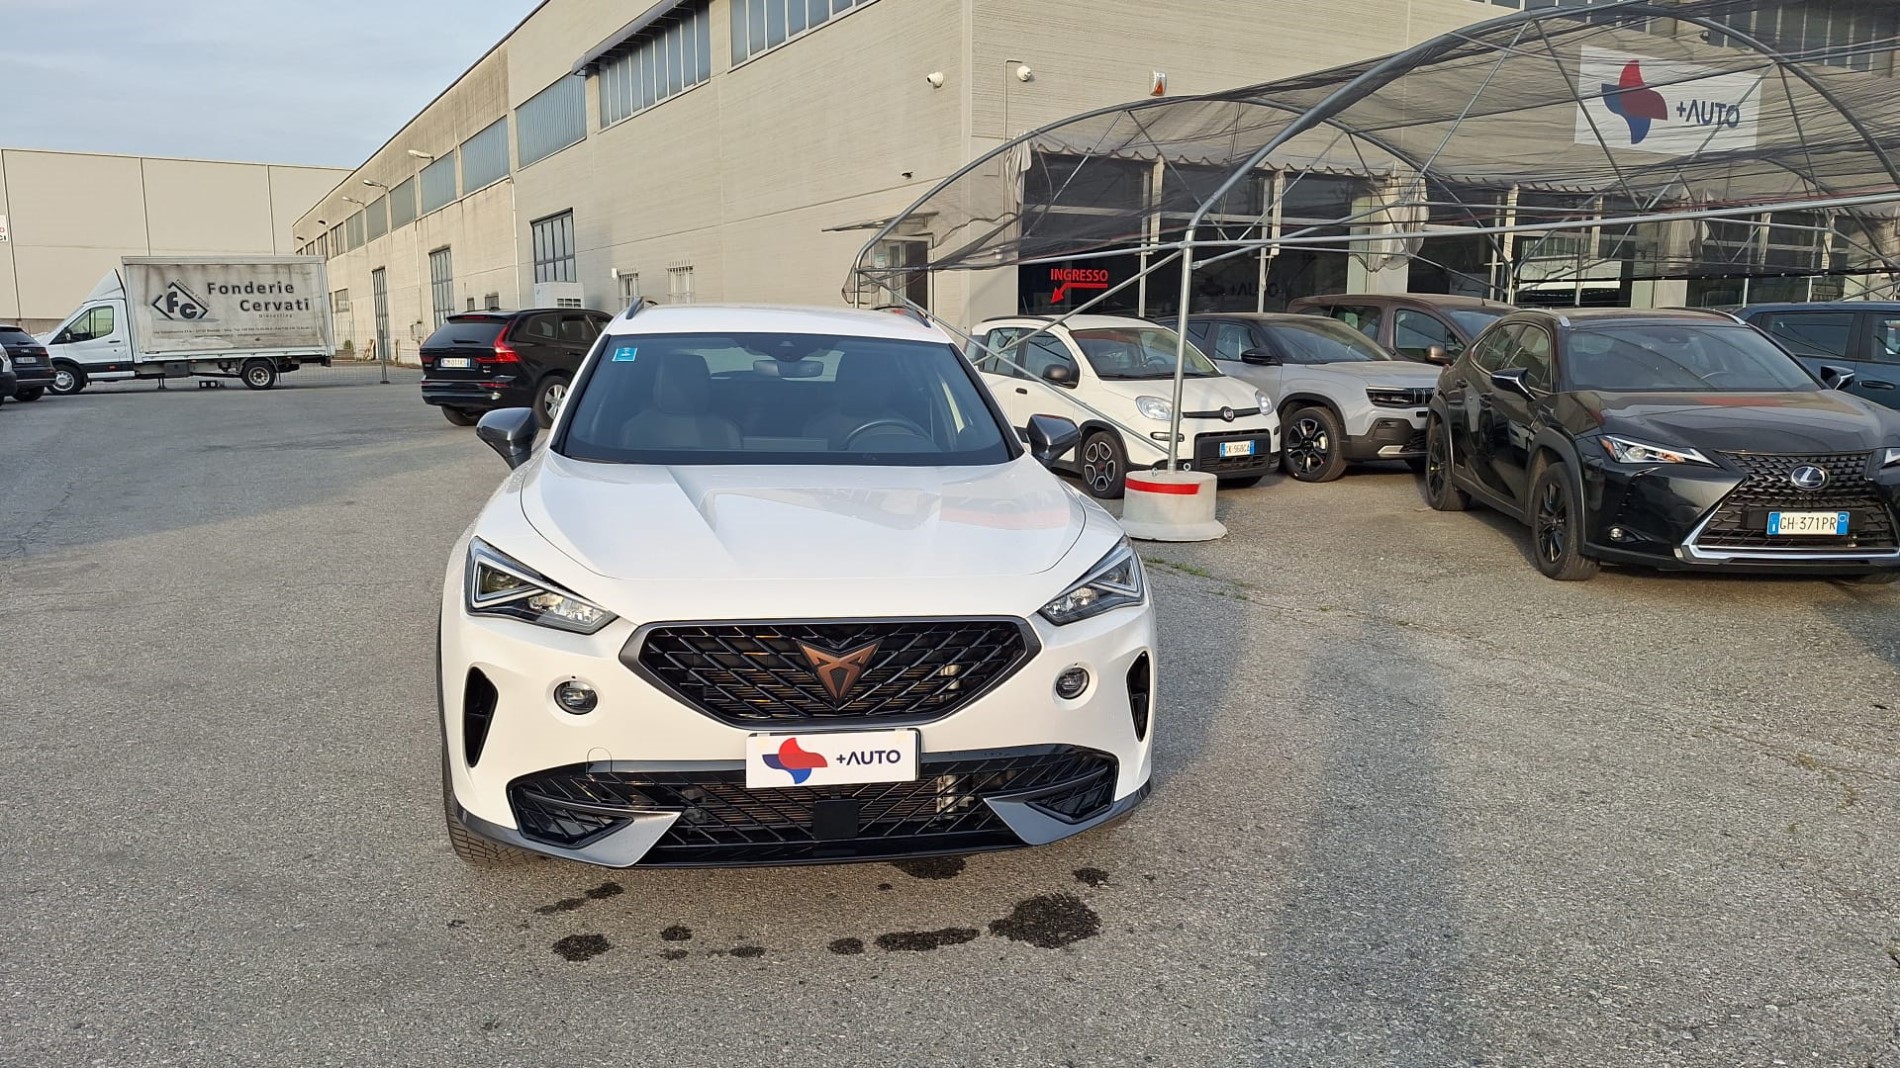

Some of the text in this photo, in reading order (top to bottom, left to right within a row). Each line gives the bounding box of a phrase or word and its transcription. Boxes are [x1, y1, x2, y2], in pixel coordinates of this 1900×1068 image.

[1676, 99, 1740, 128] +AUTO
[1050, 268, 1109, 282] INGRESSO
[207, 280, 295, 295] Fonderie
[1229, 281, 1279, 298] +AUO
[239, 297, 310, 312] Cervati
[1799, 516, 1837, 531] 371PR
[836, 749, 901, 766] +AUTO
